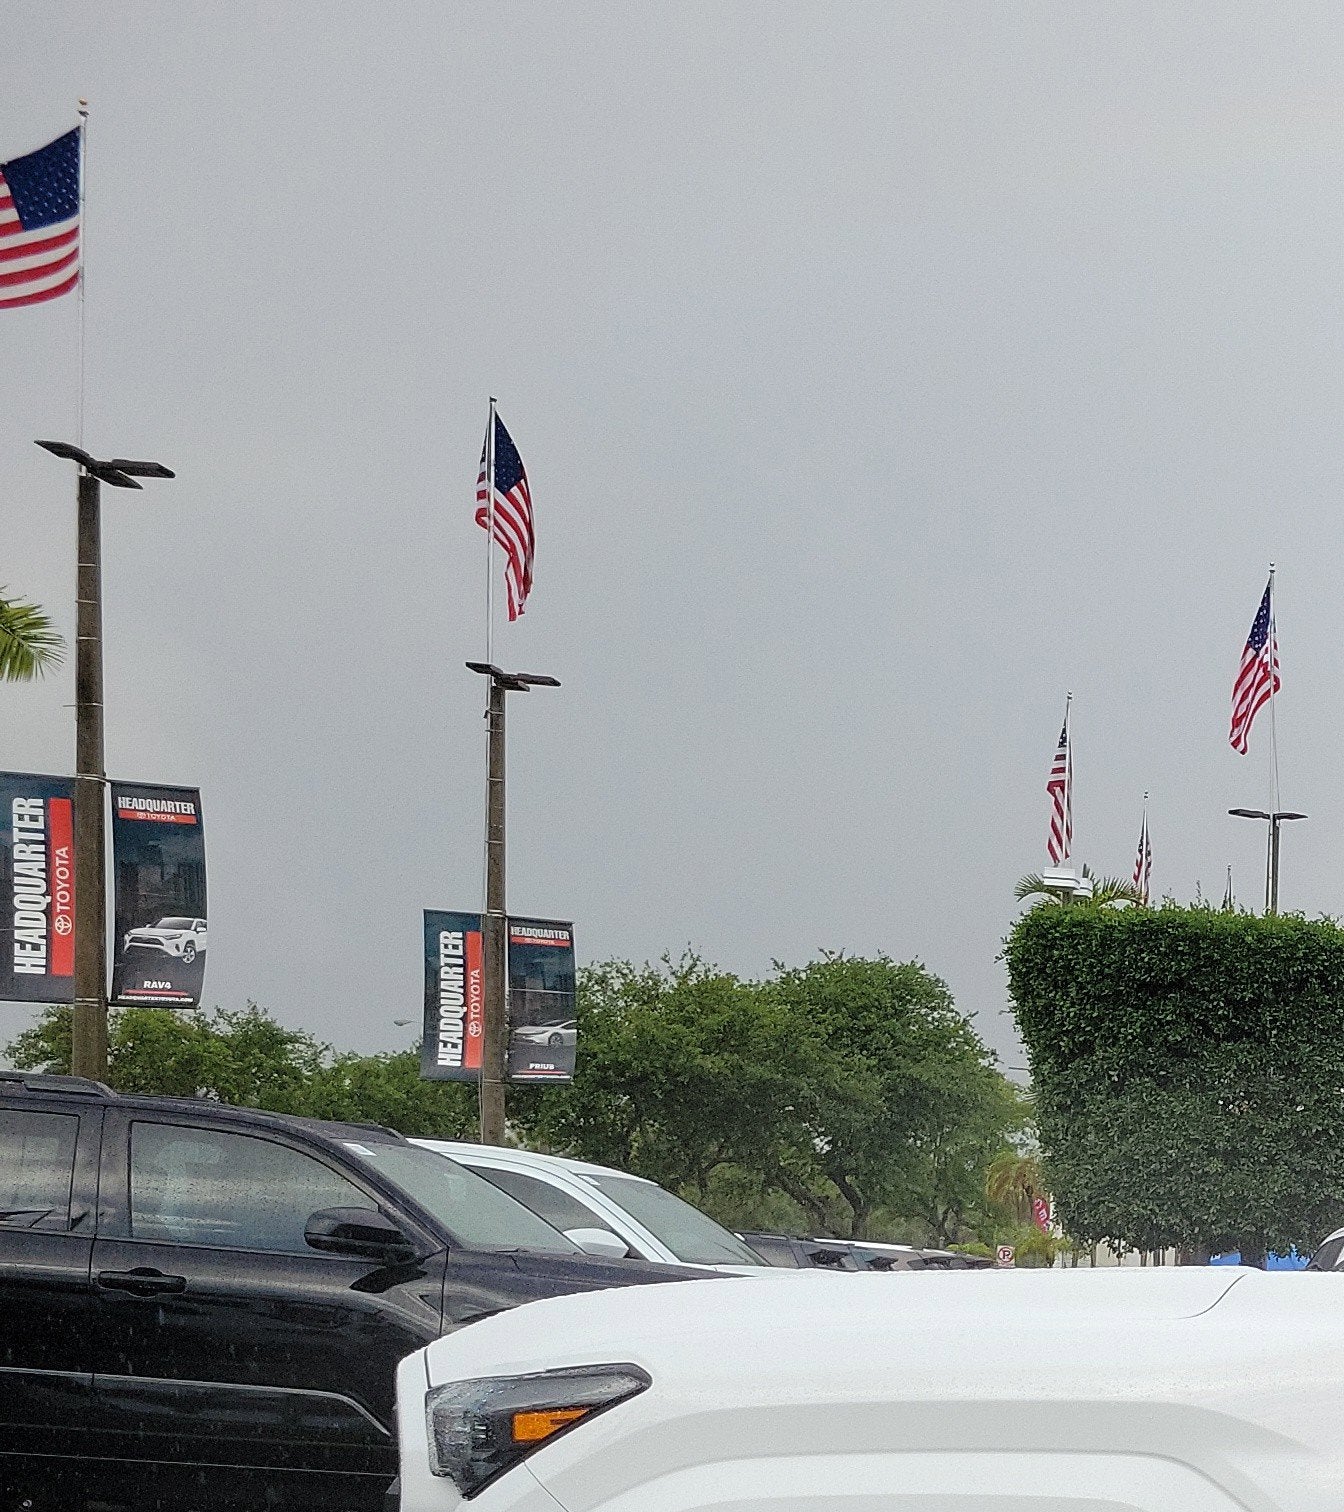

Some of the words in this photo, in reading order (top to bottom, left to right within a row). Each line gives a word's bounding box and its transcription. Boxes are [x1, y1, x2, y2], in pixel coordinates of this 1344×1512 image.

[117, 796, 196, 815] HEADQUARTER
[146, 812, 176, 821] TOYOTA
[13, 797, 51, 975] HEADQUARTER
[56, 845, 70, 913] TOYOTA
[510, 926, 570, 941] HEADQUARTER
[143, 980, 172, 990] RAV4
[437, 930, 467, 1067] HEADQUARTER
[470, 968, 480, 1019] TOYOTA
